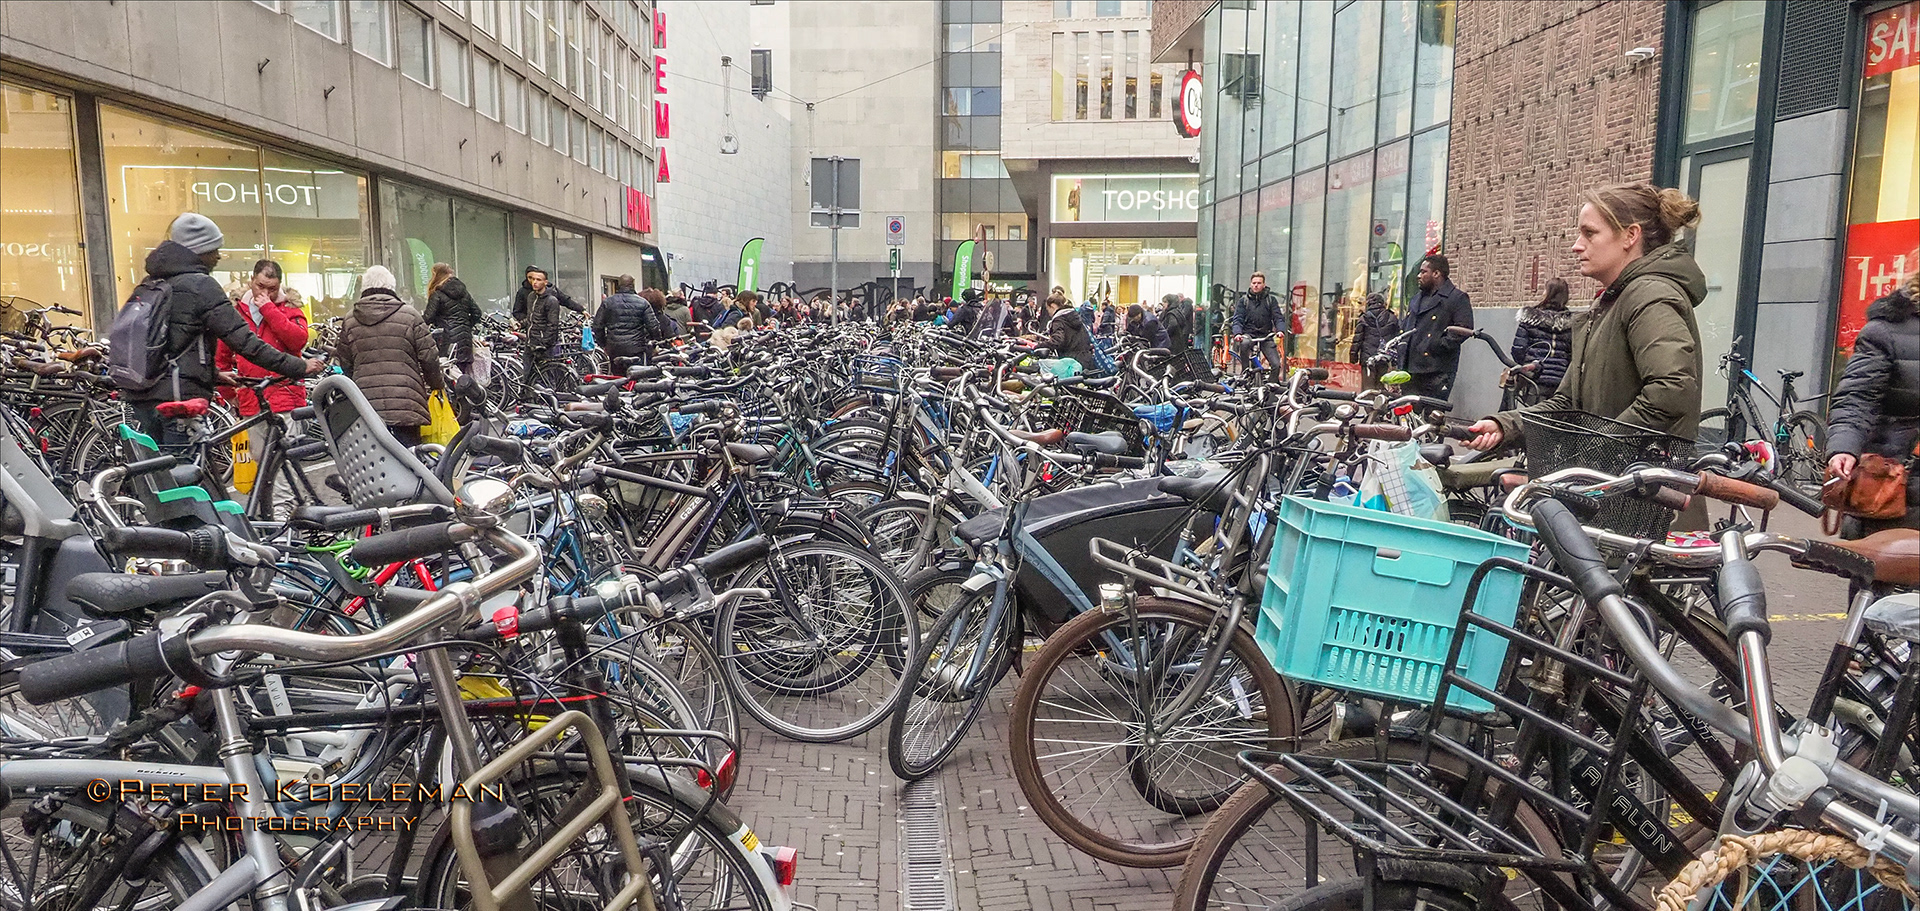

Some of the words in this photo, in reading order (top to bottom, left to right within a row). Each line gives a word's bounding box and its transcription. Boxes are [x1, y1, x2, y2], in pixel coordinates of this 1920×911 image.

[653, 8, 670, 183] HEMA
[626, 186, 652, 233] HEMA
[1101, 190, 1200, 211] TOPSHO
[958, 255, 970, 287] Shopping
[1581, 765, 1673, 854] AALON
